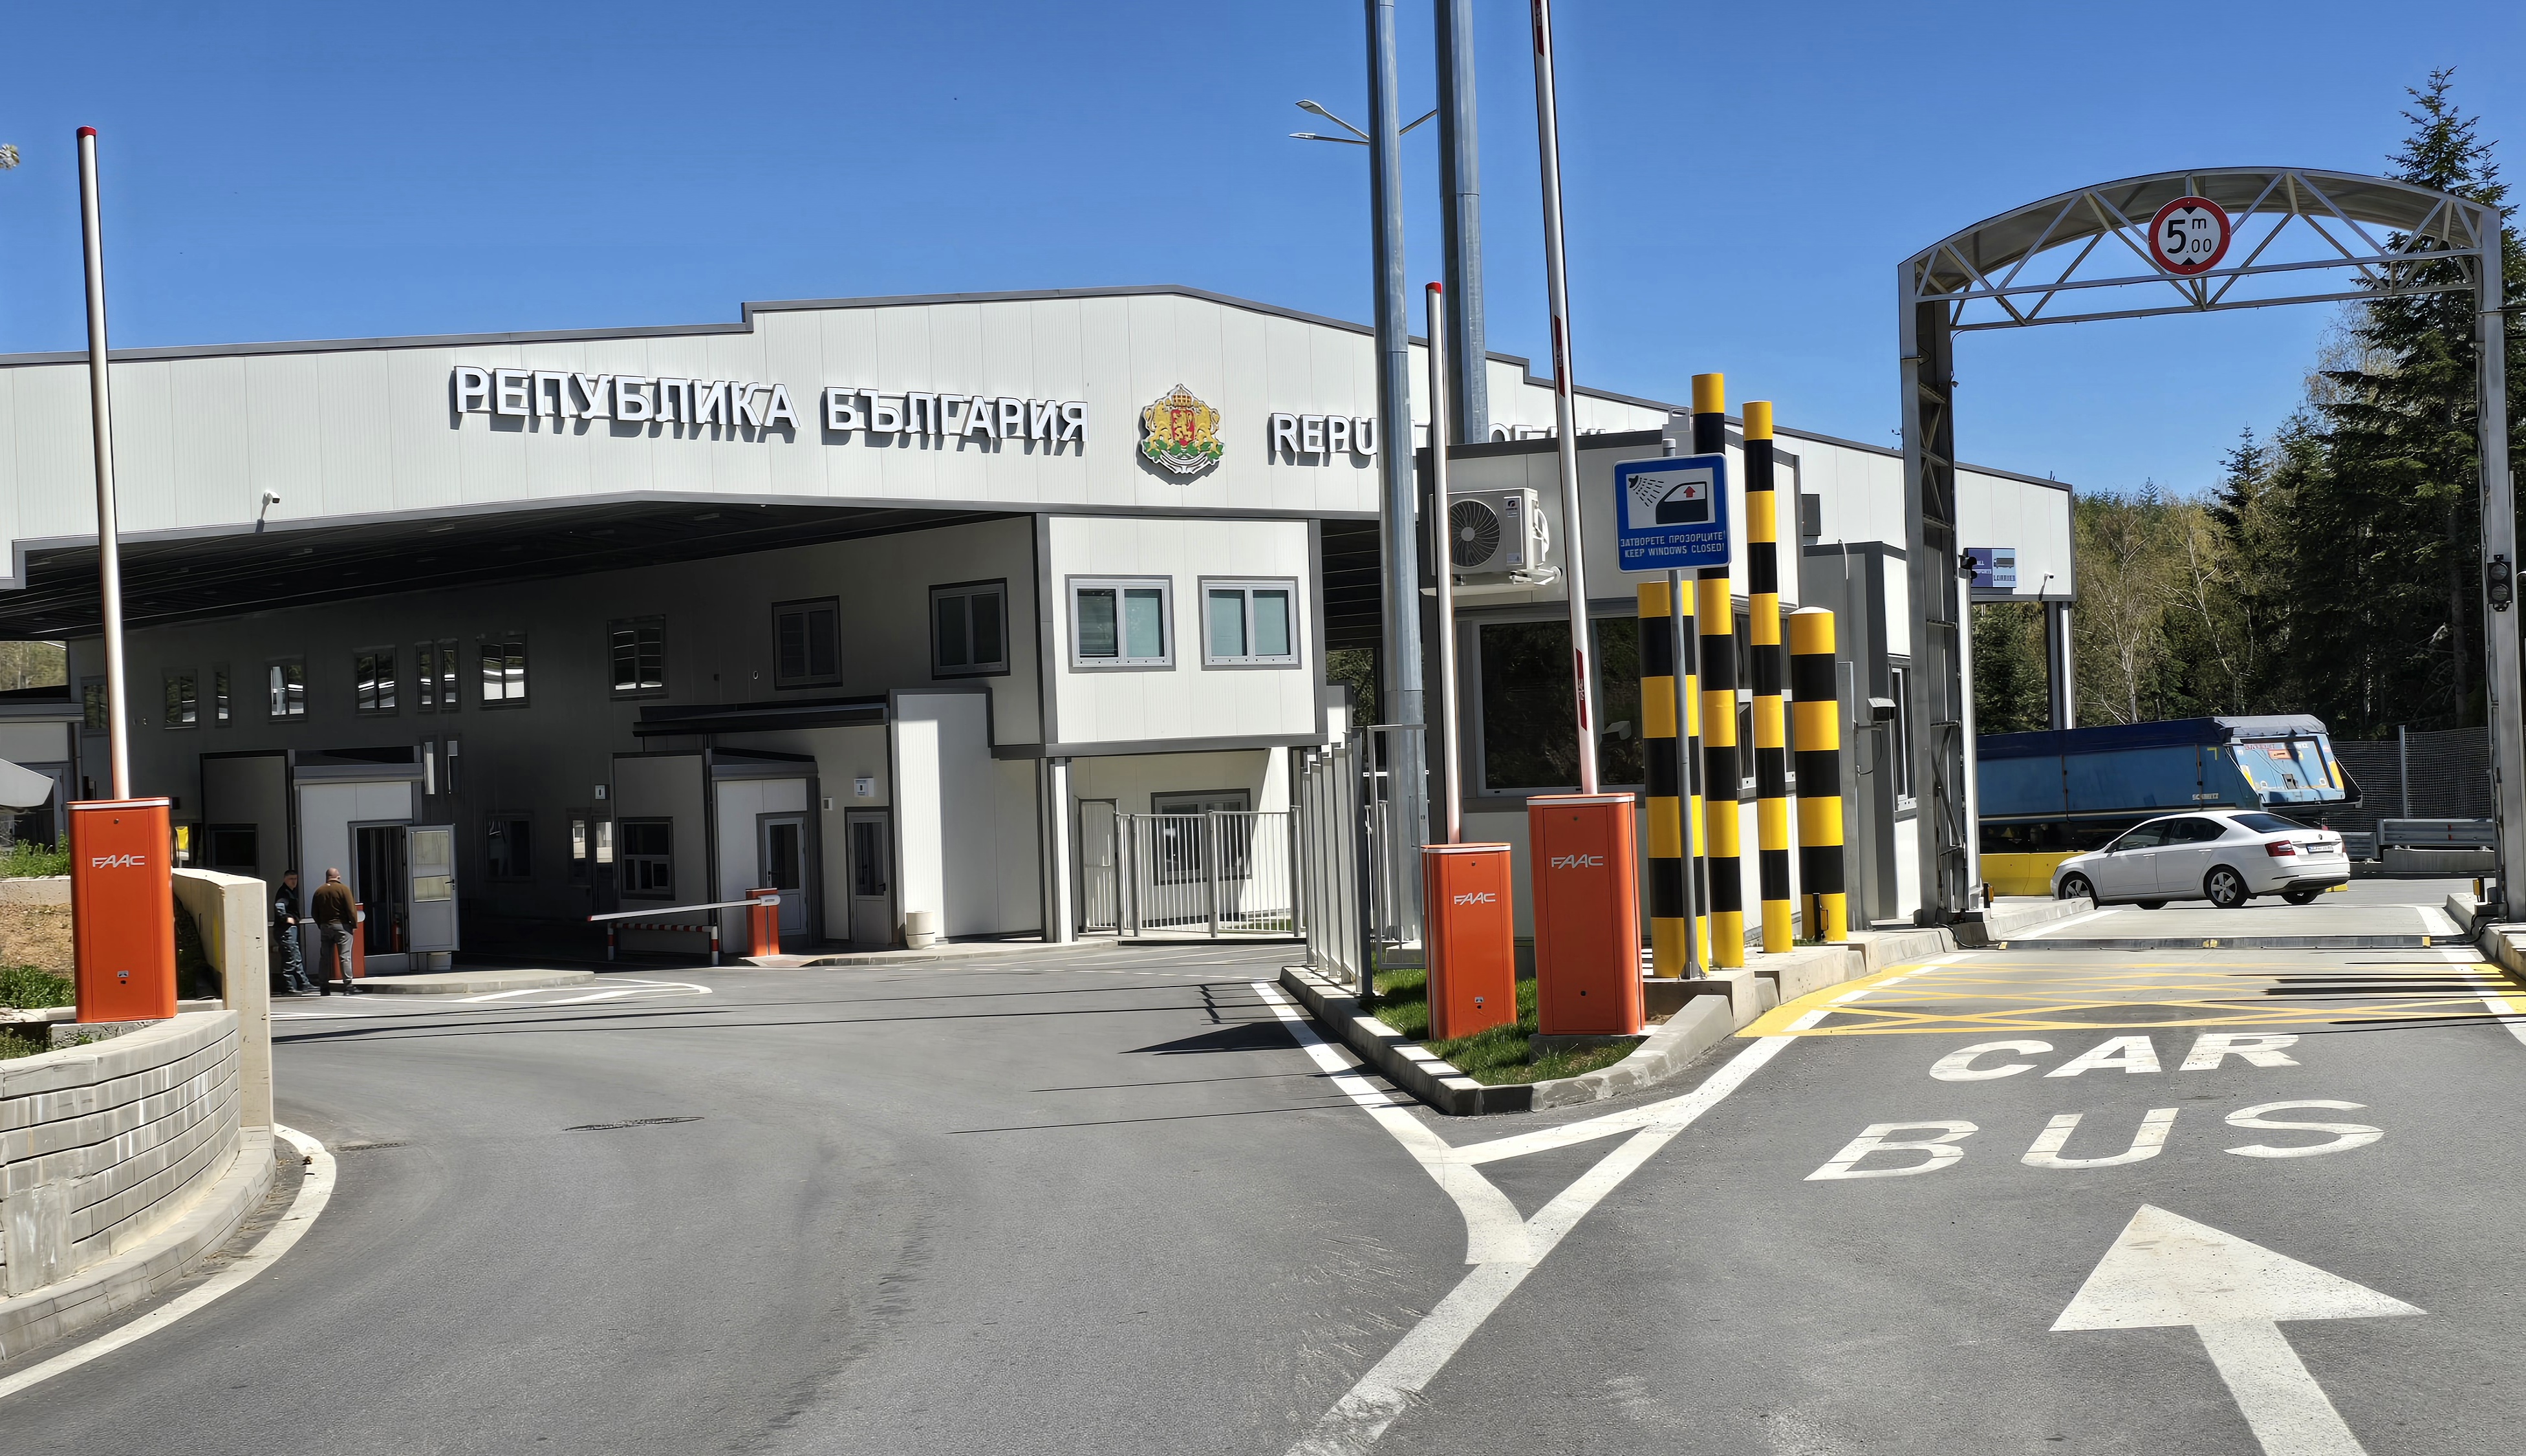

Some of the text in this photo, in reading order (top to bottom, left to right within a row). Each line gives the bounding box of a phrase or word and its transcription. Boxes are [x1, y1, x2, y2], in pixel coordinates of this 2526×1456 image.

[453, 365, 1090, 442] РЕПУБЛИКА БЪЛГАРИЯ
[1271, 412, 1416, 456] REPU
[1620, 536, 1665, 547] ЗАТВОРЕТЕ
[1625, 542, 1725, 558] KEEP WINDOWS CLOSED!
[92, 854, 146, 869] FAAC
[1551, 853, 1604, 869] FAAC
[1453, 892, 1496, 906] FAAC
[1929, 1033, 2301, 1082] CAR
[1802, 1099, 2385, 1181] BUS
